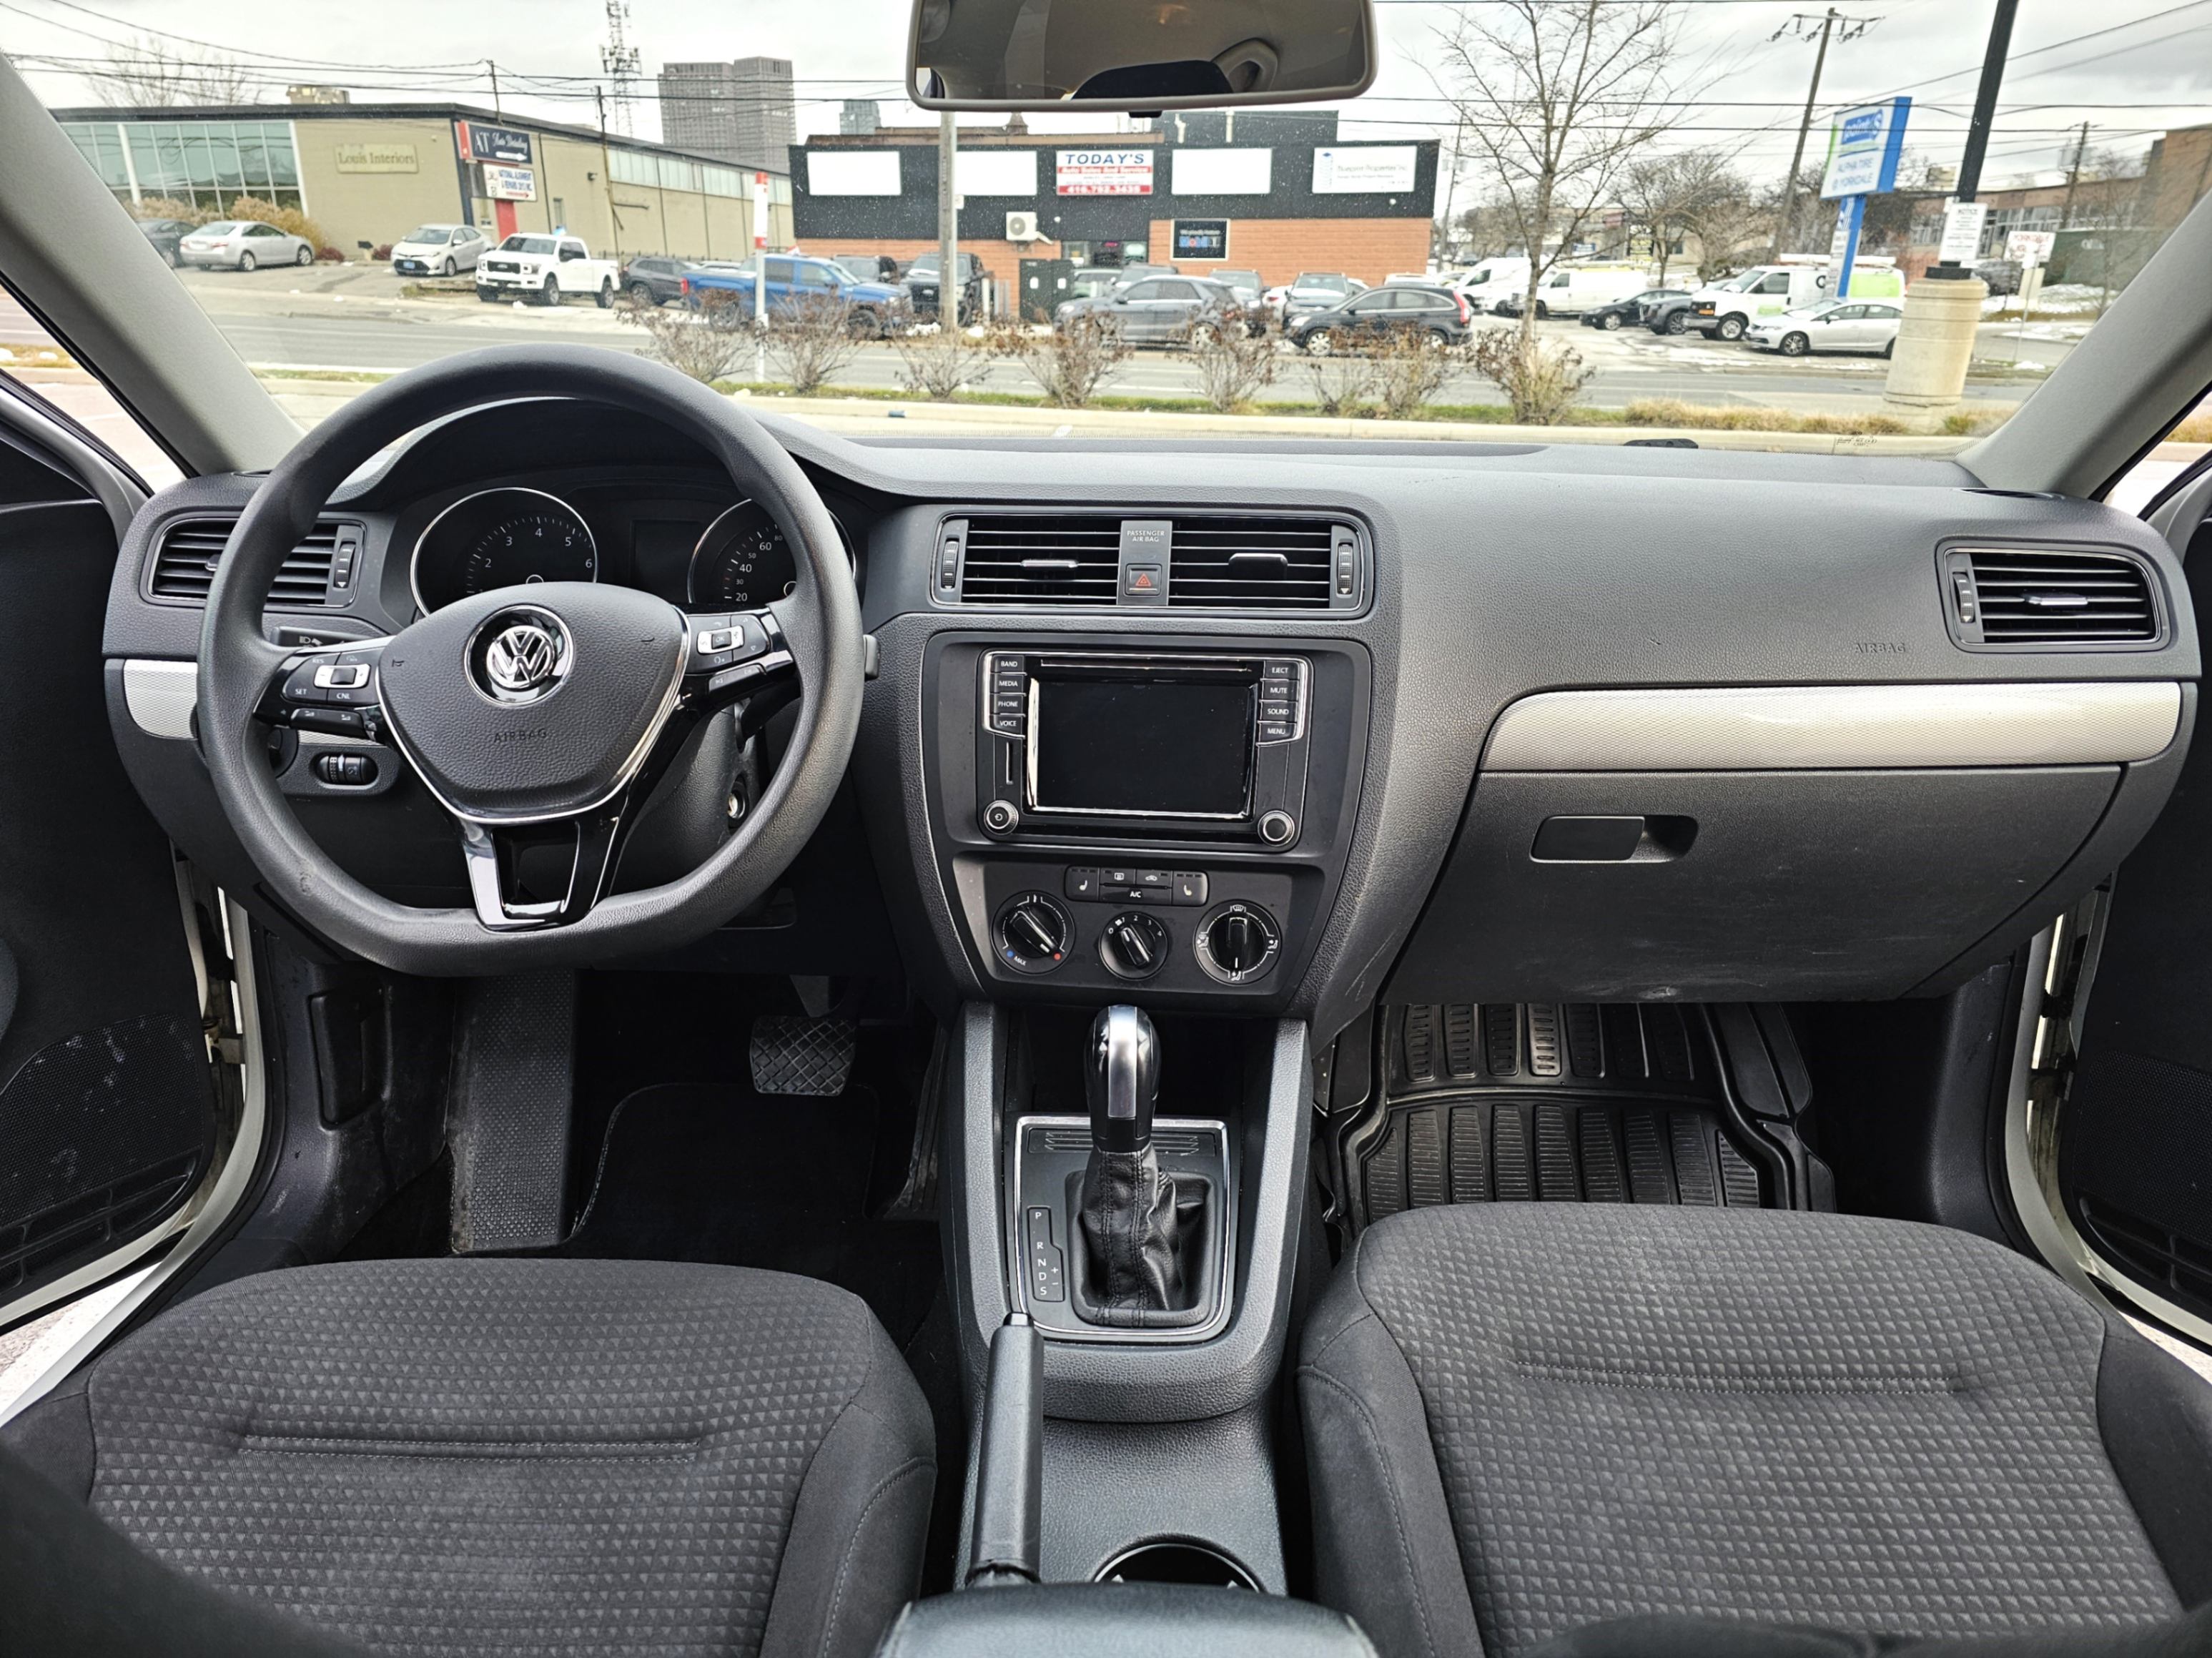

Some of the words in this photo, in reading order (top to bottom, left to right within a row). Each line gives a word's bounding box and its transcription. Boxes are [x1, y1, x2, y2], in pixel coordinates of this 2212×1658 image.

[338, 152, 367, 164] Louis
[370, 152, 415, 164] Interiors
[1065, 153, 1145, 164] TODAY'S
[535, 528, 543, 538] 4
[505, 536, 513, 546] 3
[565, 536, 572, 547] 5
[759, 542, 772, 551] 60
[485, 558, 492, 568] 2
[585, 558, 593, 568] 6
[739, 563, 752, 573] 40
[736, 592, 748, 602] 20
[1855, 643, 1906, 653] AIRBAG
[493, 727, 547, 744] AIRBAG
[1013, 955, 1027, 966] MAX
[1035, 1211, 1042, 1220] P
[1036, 1241, 1044, 1250] R
[1037, 1258, 1047, 1267] N
[1038, 1272, 1047, 1281] D
[1040, 1286, 1047, 1296] S
